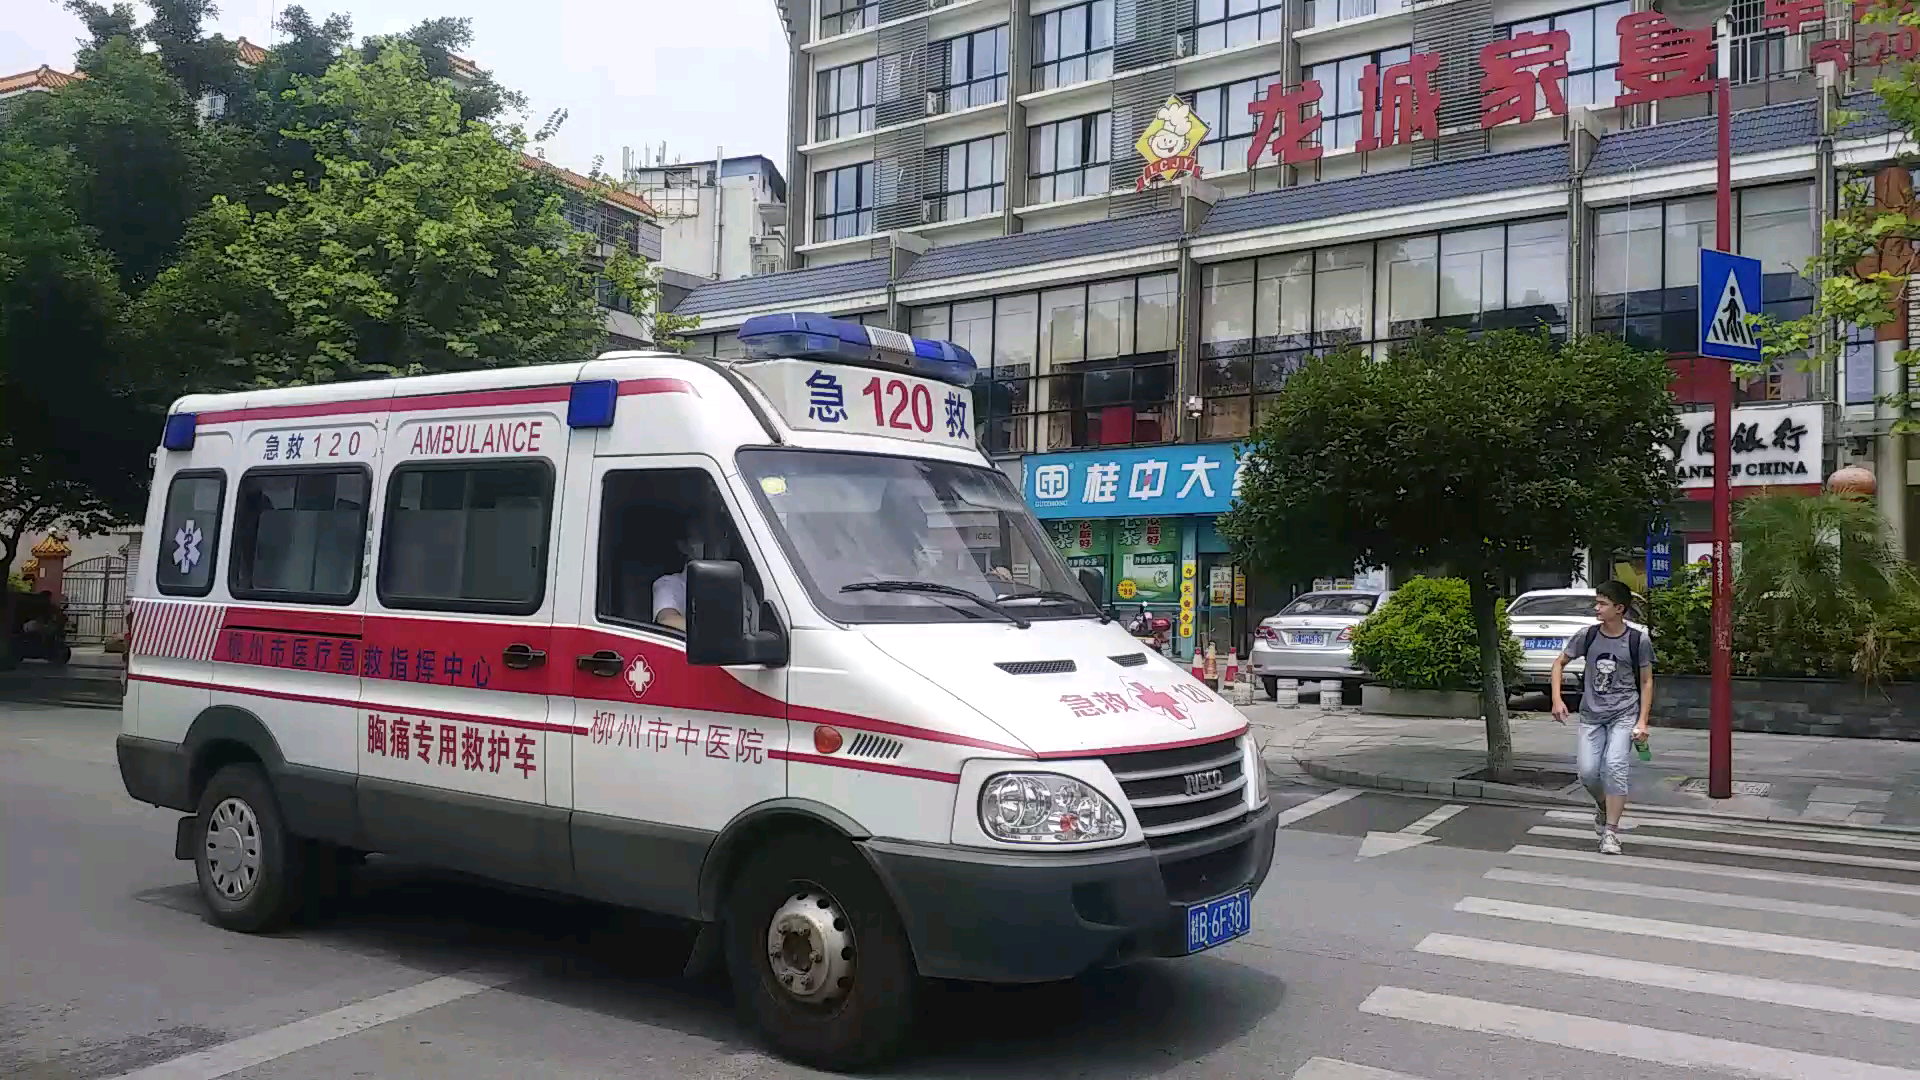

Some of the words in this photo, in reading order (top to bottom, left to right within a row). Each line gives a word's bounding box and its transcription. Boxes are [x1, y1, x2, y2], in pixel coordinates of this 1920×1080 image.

[1150, 157, 1192, 174] LCJY
[805, 370, 848, 423] 急
[863, 376, 933, 433] 120
[944, 391, 969, 439] 救
[411, 421, 543, 455] AMBULANCE
[1668, 464, 1714, 479] ANK
[1745, 460, 1808, 476] CHINA
[227, 630, 492, 688] 柳州市医疗急救指挥中心
[367, 713, 537, 780] 胸痛专用救护车
[590, 709, 765, 765] 柳州市中医院
